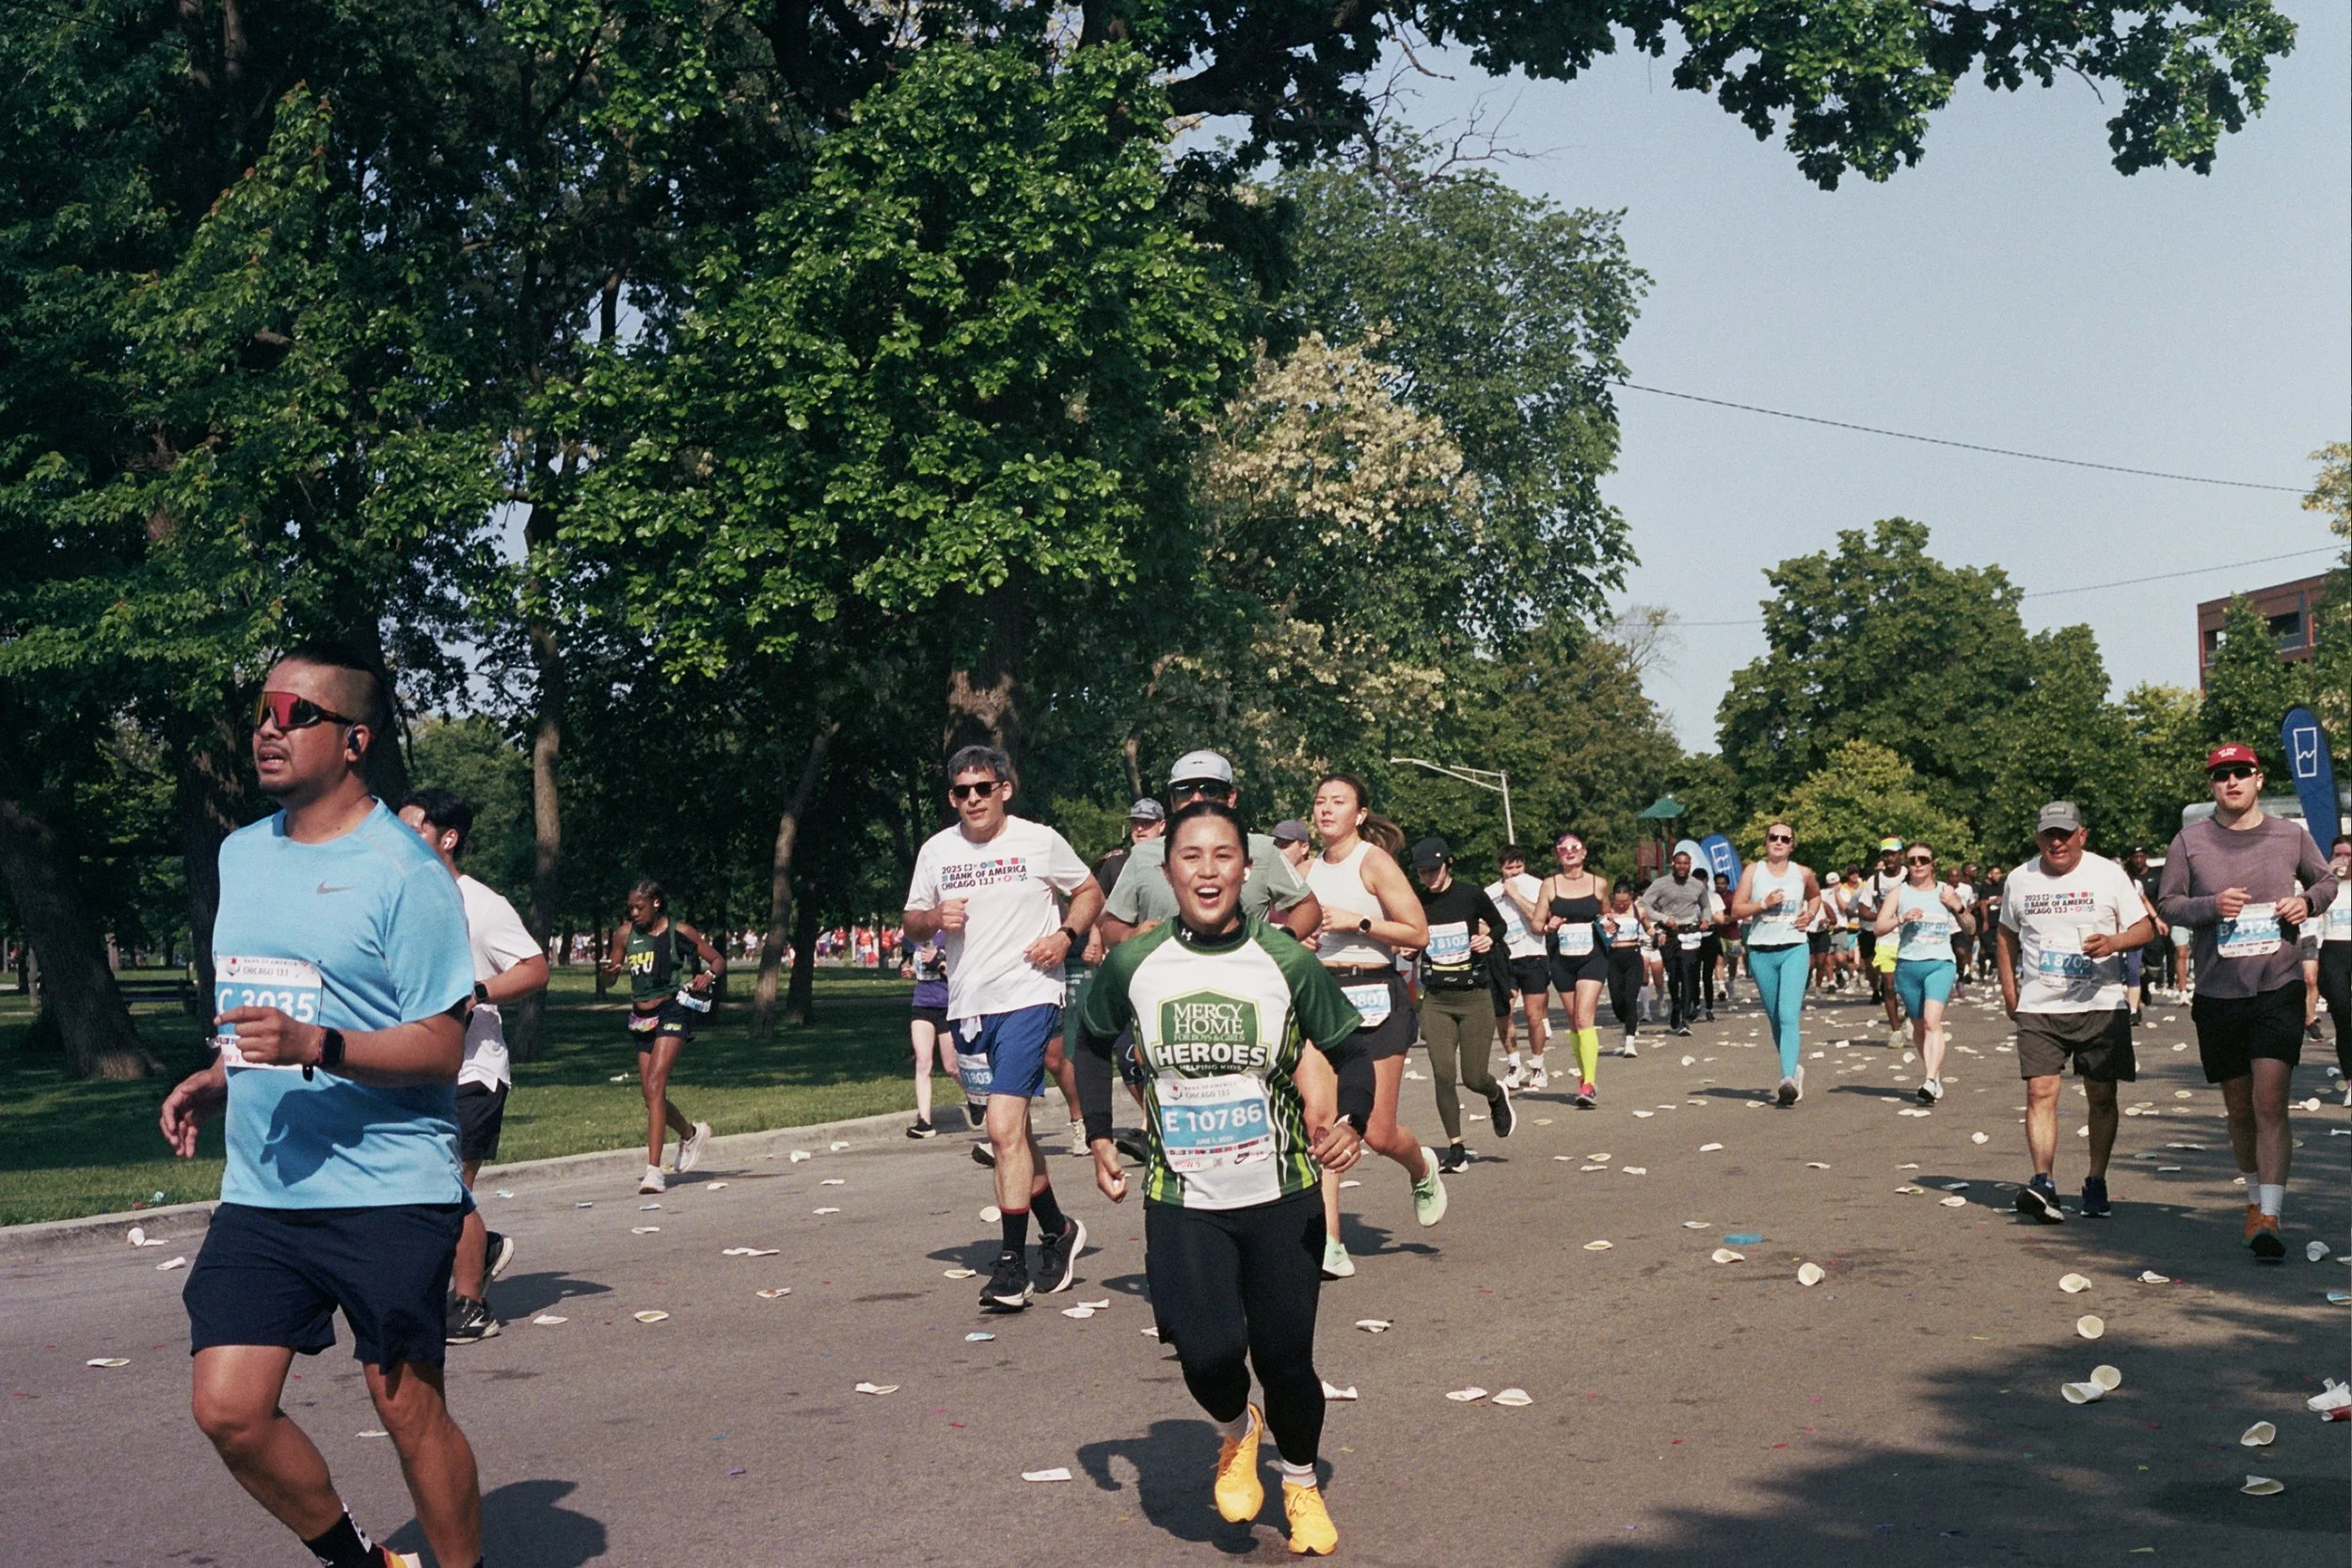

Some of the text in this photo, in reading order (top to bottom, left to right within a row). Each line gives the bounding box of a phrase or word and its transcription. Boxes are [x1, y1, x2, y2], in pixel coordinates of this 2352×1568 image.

[942, 865, 962, 875] 2025
[949, 864, 1026, 881] BANK OF AMERICA
[941, 877, 994, 891] CHICAGO 13.1
[2061, 898, 2094, 907] AMERICA
[1438, 934, 1468, 949] 8102
[2041, 953, 2051, 966] A
[243, 966, 274, 975] CHICAGO
[218, 988, 316, 1023] C 3035
[1174, 1003, 1243, 1020] MERCY
[1174, 1018, 1245, 1035] HOME
[1191, 1034, 1213, 1042] BOYS
[1155, 1042, 1266, 1067] HEROES
[1185, 1091, 1216, 1100] CHICAGO
[1165, 1103, 1263, 1132] E 10786
